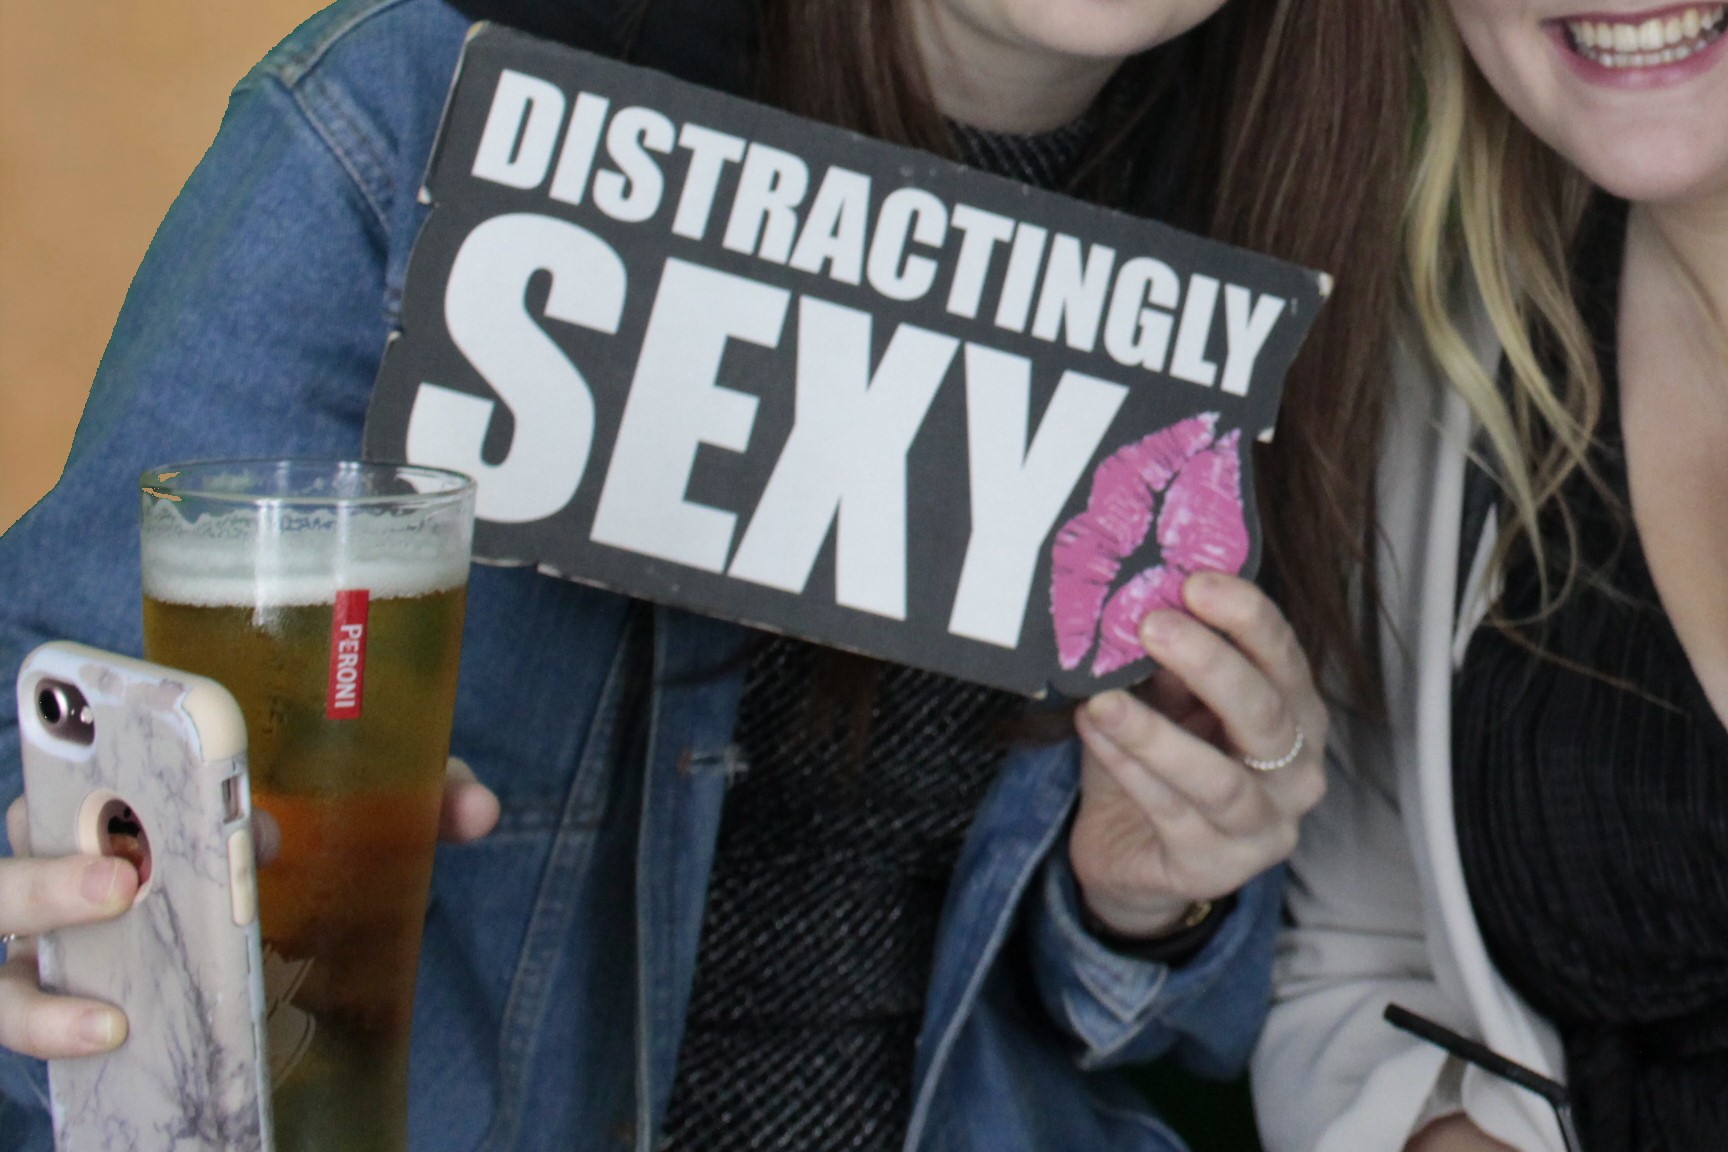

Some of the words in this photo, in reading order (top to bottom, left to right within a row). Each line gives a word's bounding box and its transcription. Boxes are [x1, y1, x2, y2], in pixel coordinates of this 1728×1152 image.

[472, 69, 1285, 397] DISTRACTINGLY
[405, 212, 1130, 649] SEXY
[334, 624, 363, 708] PERONI
